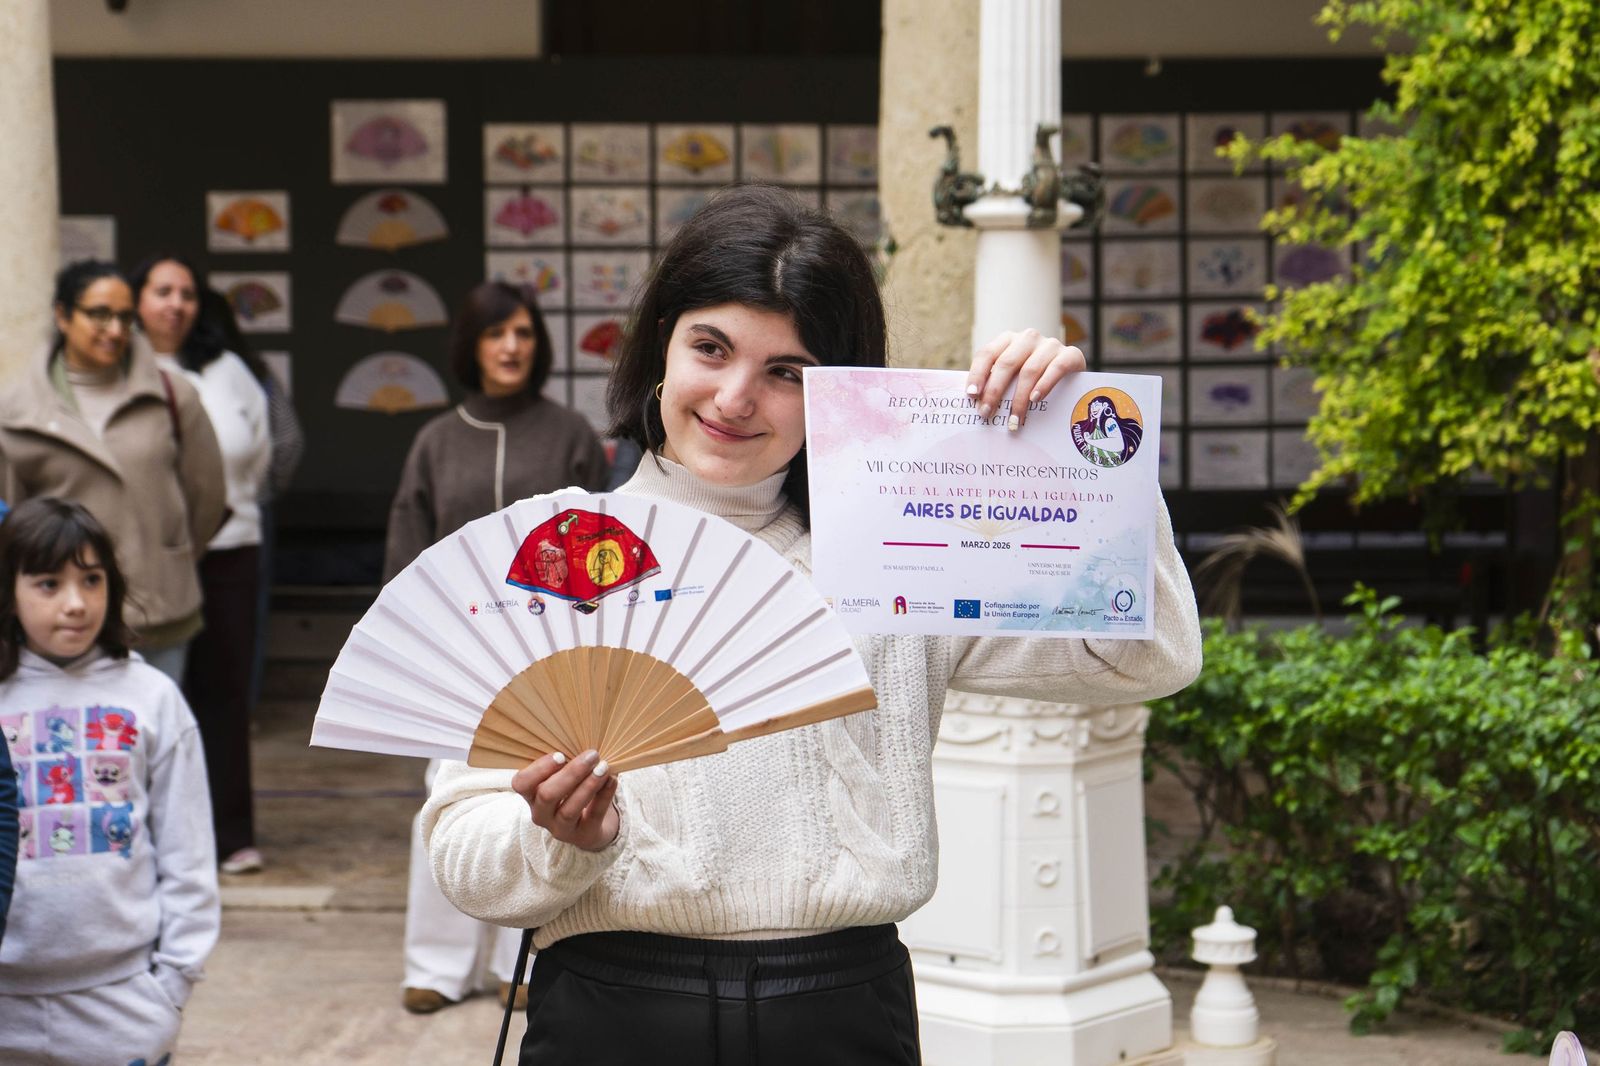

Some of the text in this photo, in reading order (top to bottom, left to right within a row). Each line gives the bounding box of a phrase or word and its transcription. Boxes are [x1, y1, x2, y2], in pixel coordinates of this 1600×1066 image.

[888, 397, 1049, 412] RECONOCIMT DE
[911, 413, 1027, 427] PARTICIPACI
[866, 460, 1099, 481] VII CONCURSO INTERCENTROS
[879, 485, 1114, 503] DALE AL ARTE POR LA IGUALDAD
[903, 501, 1078, 523] AIRES DE IGUALDAD
[960, 540, 1012, 550] MARZO 2026
[841, 598, 881, 607] ALMERÍA
[984, 601, 1028, 610] Cofinanciado
[991, 610, 1011, 618] Unión
[1012, 611, 1040, 619] Europea
[1103, 614, 1119, 622] Pacto
